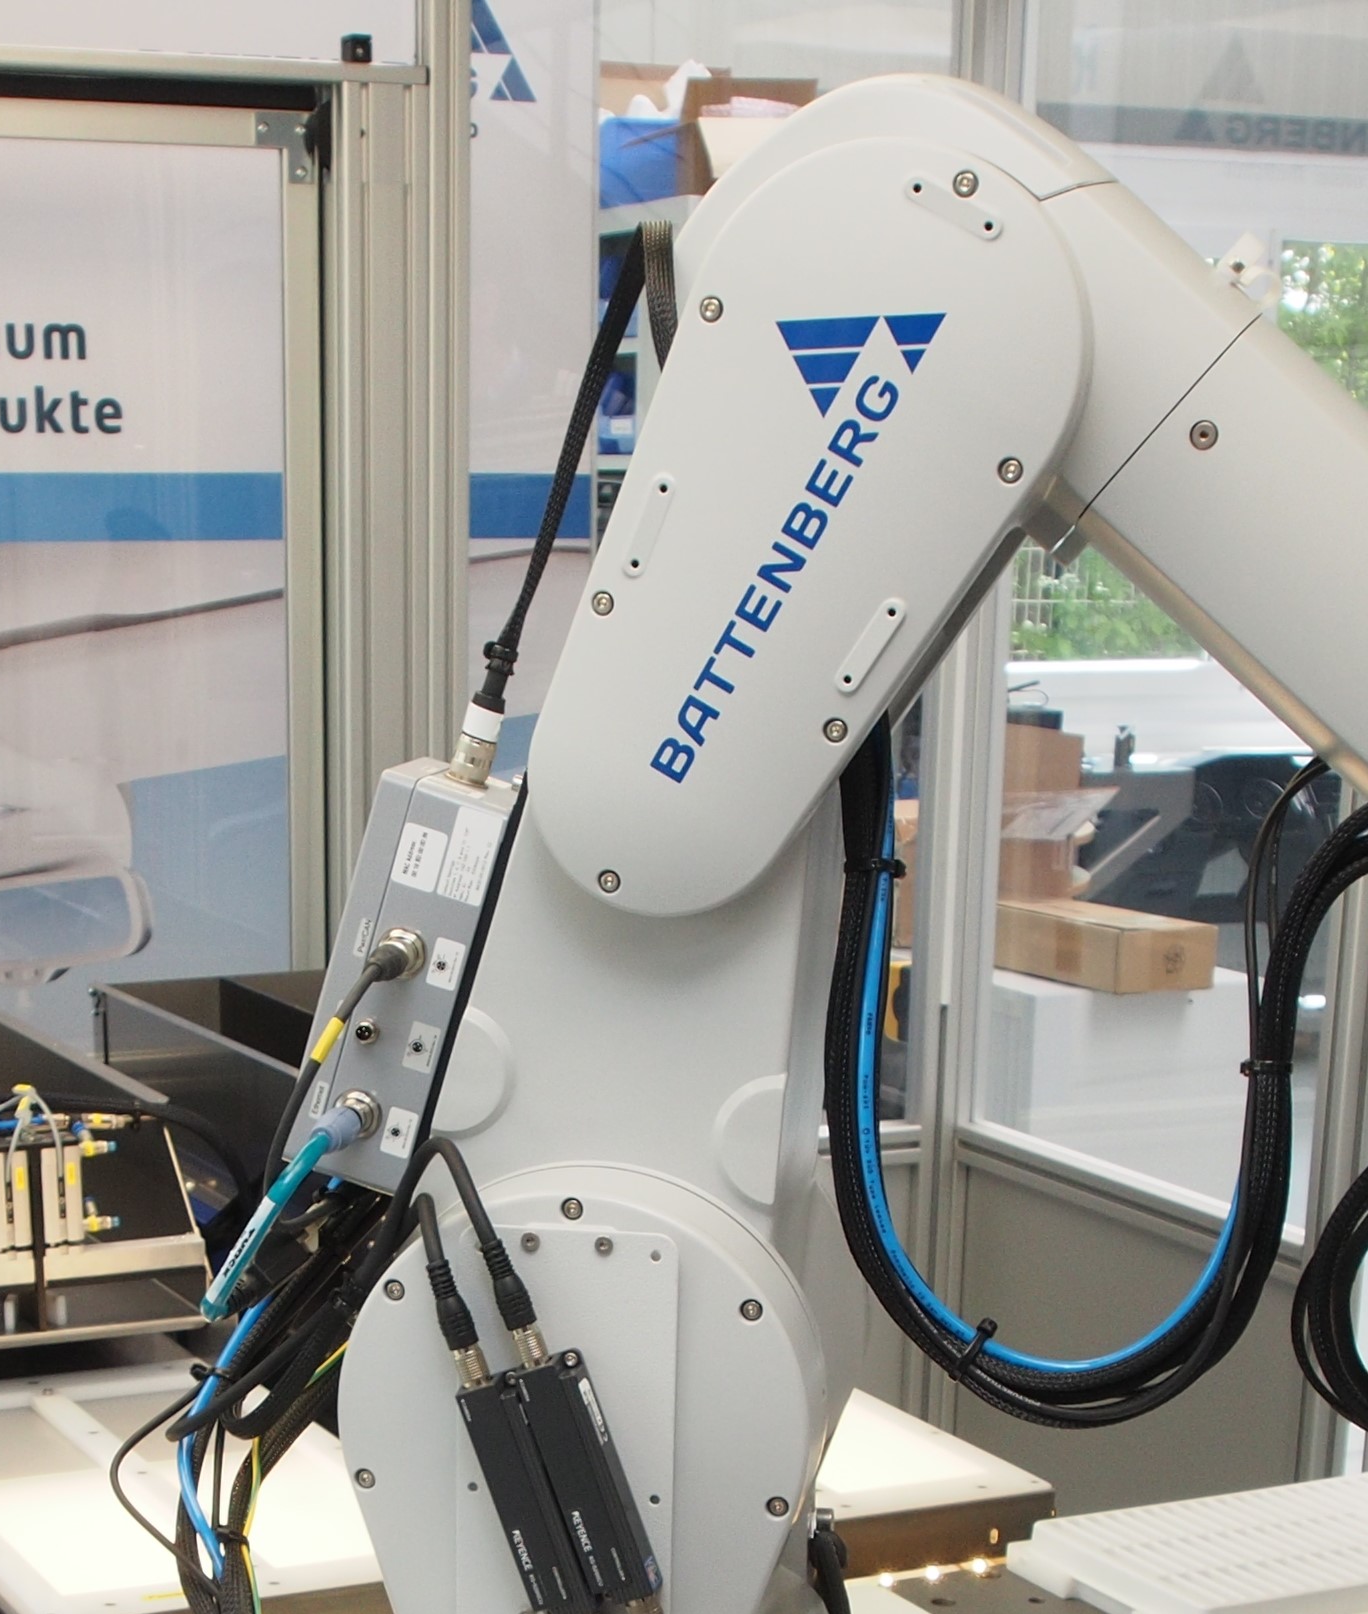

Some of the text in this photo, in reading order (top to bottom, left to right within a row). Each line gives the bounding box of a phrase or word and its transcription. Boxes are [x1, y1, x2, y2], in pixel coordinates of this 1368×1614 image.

[649, 374, 899, 784] BATTENBERG
[511, 1529, 534, 1572] KEYENCE
[571, 1510, 593, 1553] KEYENCE
